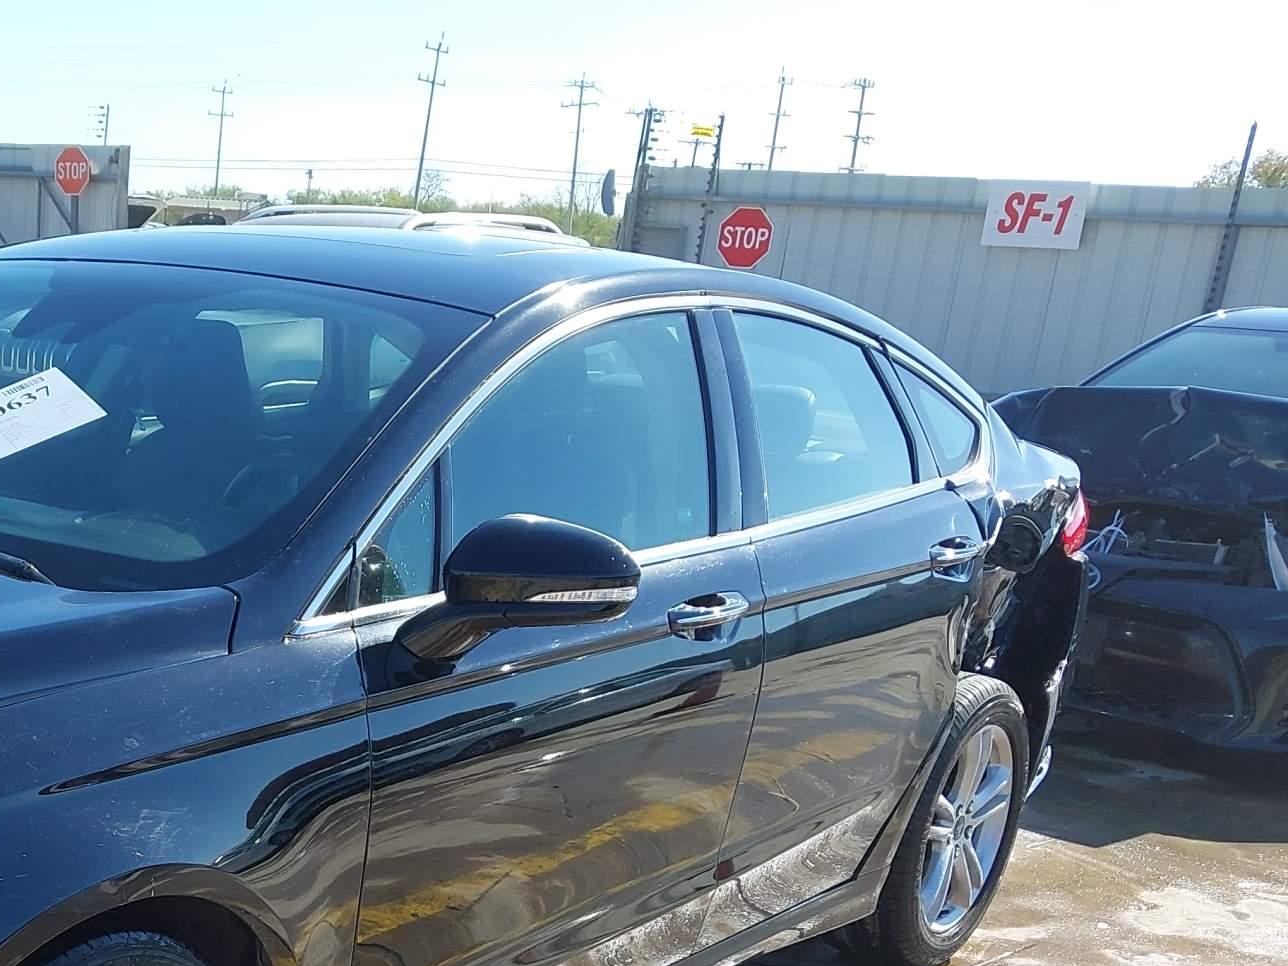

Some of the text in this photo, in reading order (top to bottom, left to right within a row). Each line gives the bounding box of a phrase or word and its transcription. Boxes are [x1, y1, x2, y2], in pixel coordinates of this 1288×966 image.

[57, 162, 87, 180] STOP
[997, 191, 1074, 235] SF-1
[721, 225, 769, 249] STOP
